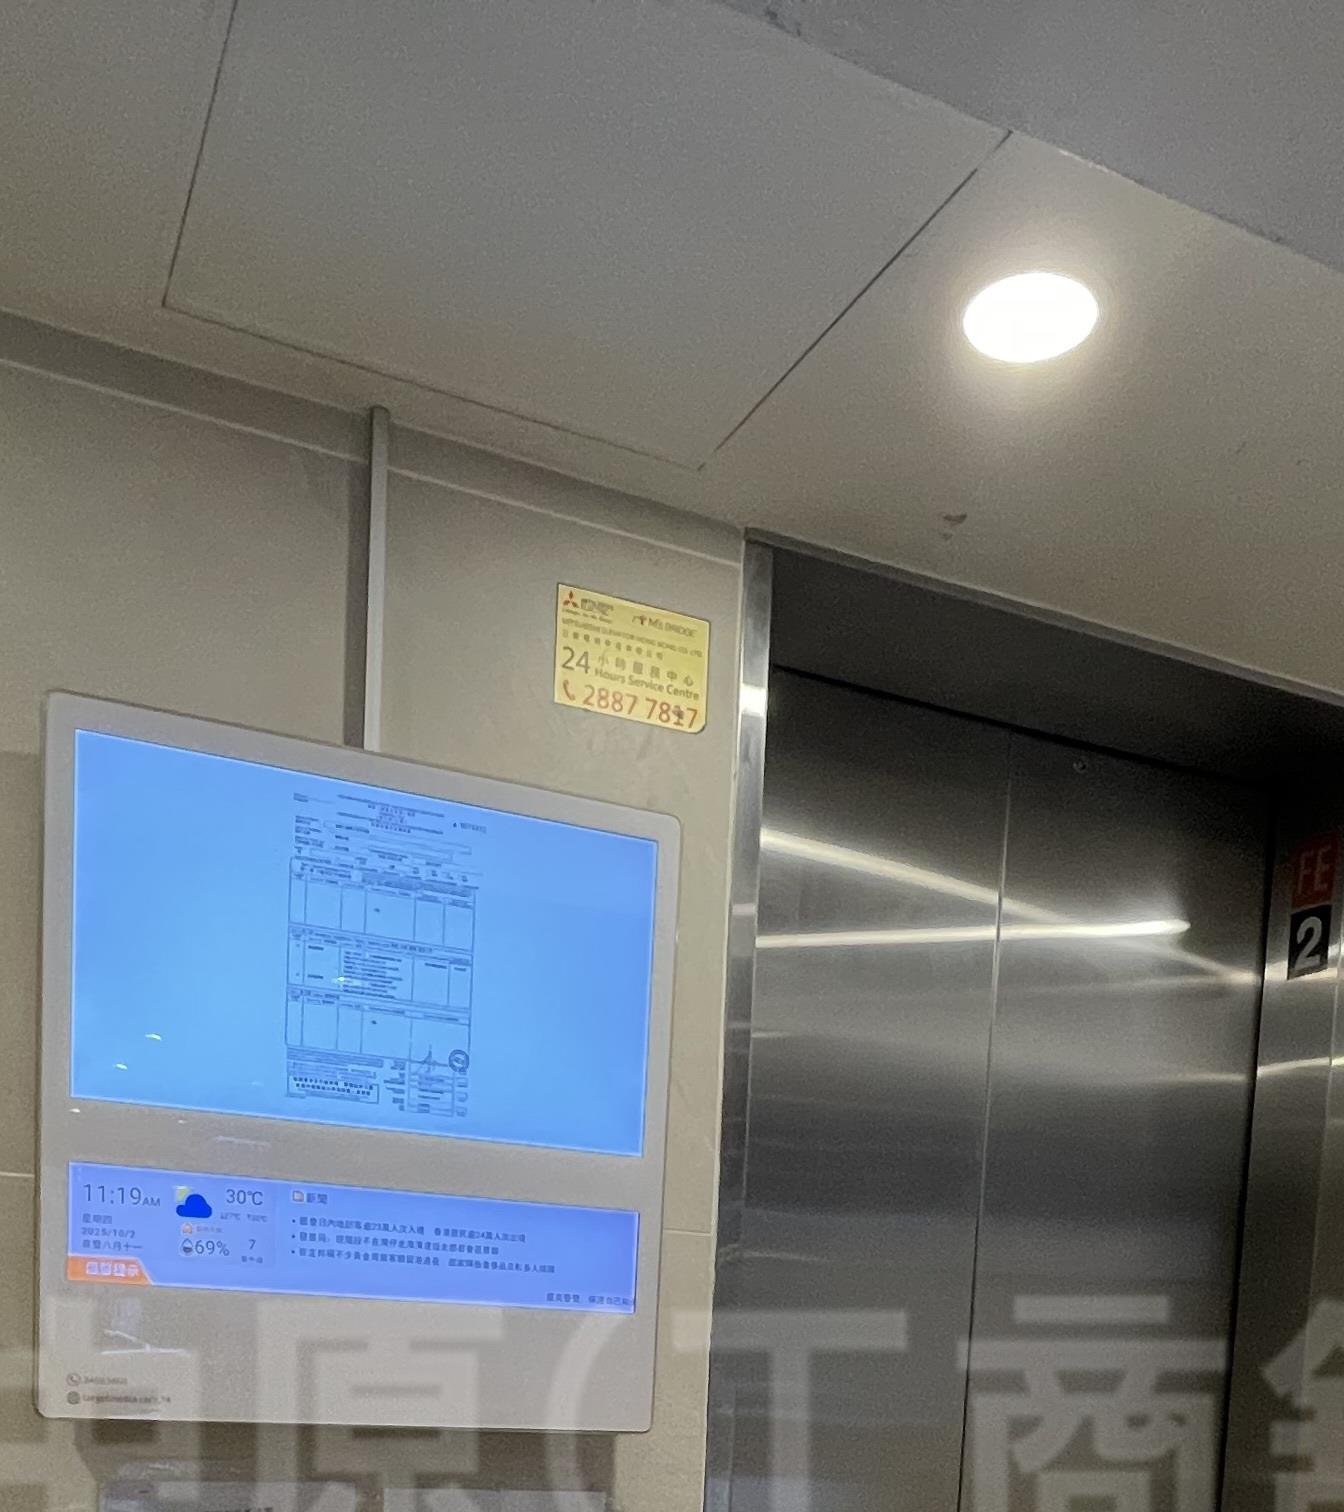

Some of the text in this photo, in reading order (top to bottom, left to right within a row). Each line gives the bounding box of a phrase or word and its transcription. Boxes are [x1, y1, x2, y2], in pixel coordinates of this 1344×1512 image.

[561, 646, 590, 674] 24
[594, 668, 699, 701] Hours Service Centre
[583, 684, 638, 715] 2887
[1296, 916, 1323, 973] 2
[194, 1239, 230, 1257] 69%
[248, 1239, 256, 1250] 7
